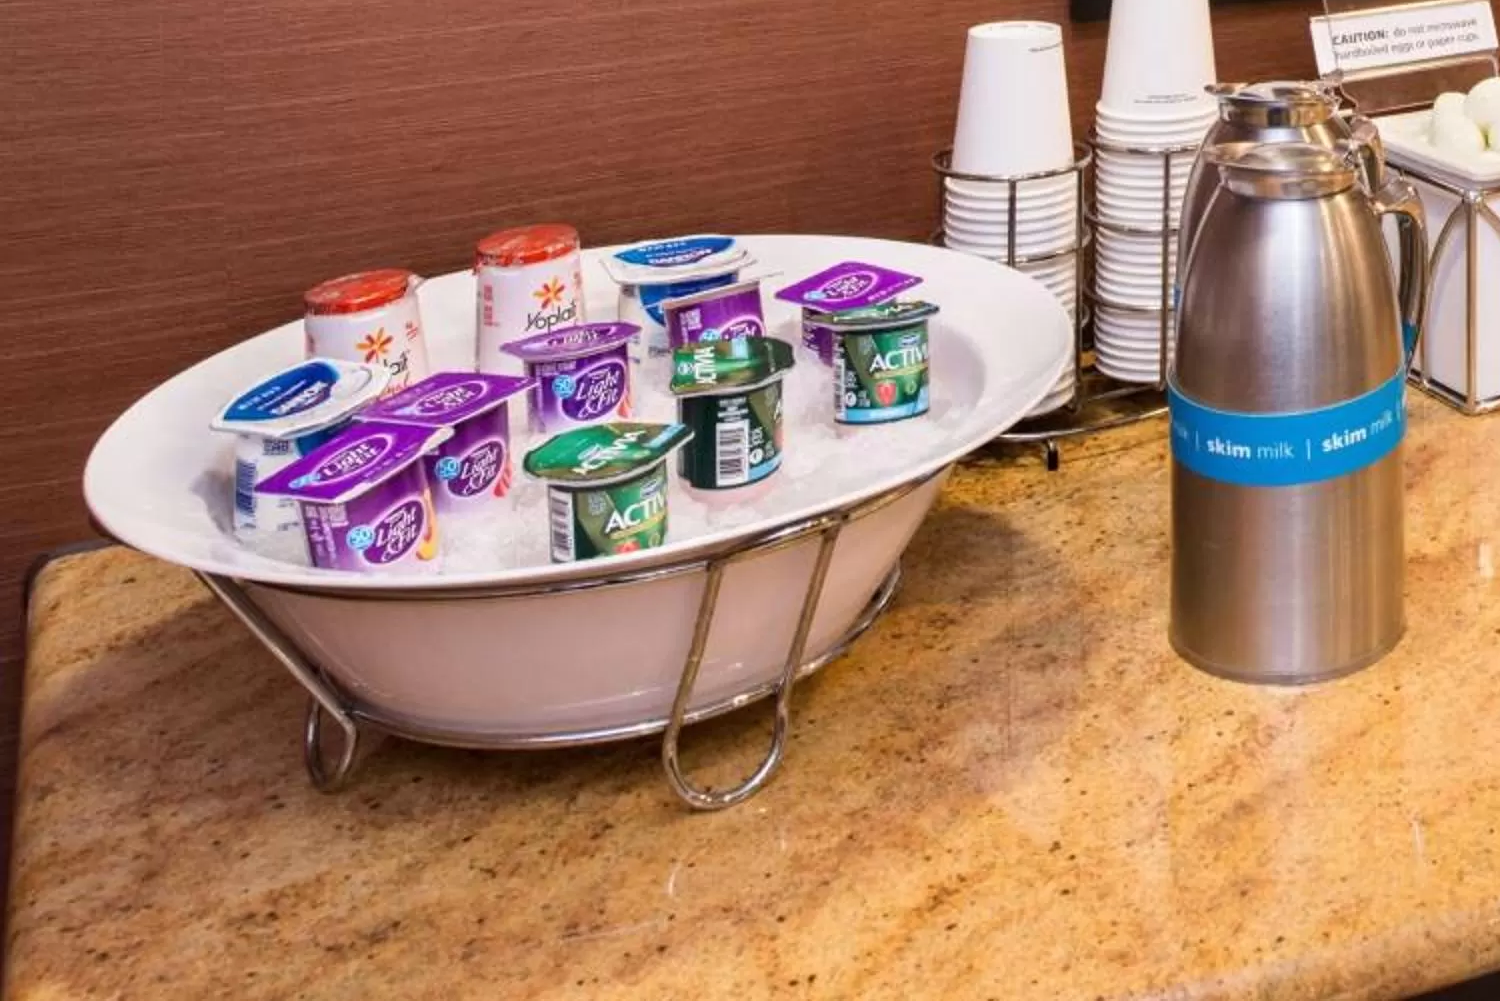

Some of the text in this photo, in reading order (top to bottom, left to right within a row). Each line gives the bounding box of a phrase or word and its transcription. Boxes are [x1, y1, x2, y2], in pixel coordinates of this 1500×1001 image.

[1332, 29, 1389, 46] CAUTION:
[525, 299, 577, 335] Yoplait
[1206, 437, 1251, 460] skim
[1256, 441, 1294, 460] milk
[1321, 427, 1367, 453] skim
